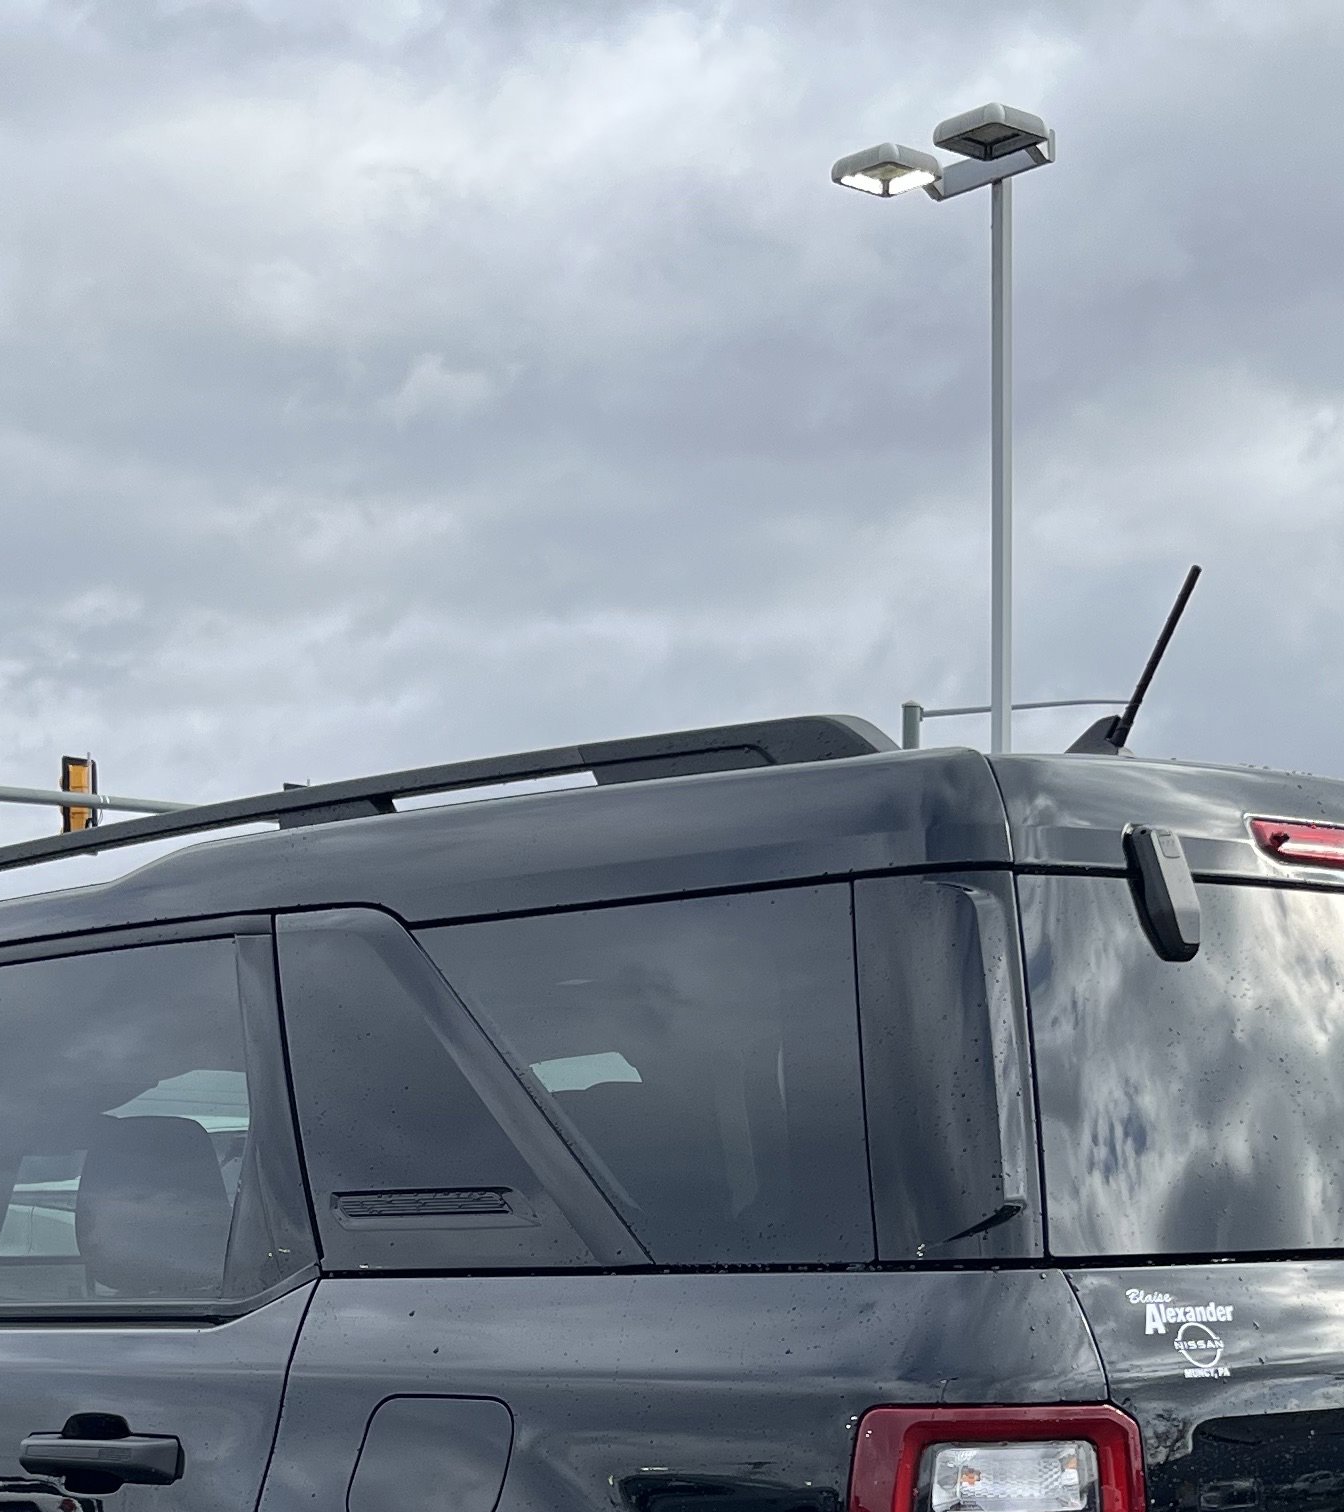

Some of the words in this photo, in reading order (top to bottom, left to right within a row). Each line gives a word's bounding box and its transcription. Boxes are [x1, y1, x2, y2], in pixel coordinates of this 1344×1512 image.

[1126, 1288, 1173, 1304] Blaise
[1145, 1302, 1234, 1335] Alexander
[1174, 1339, 1225, 1350] NISSAN
